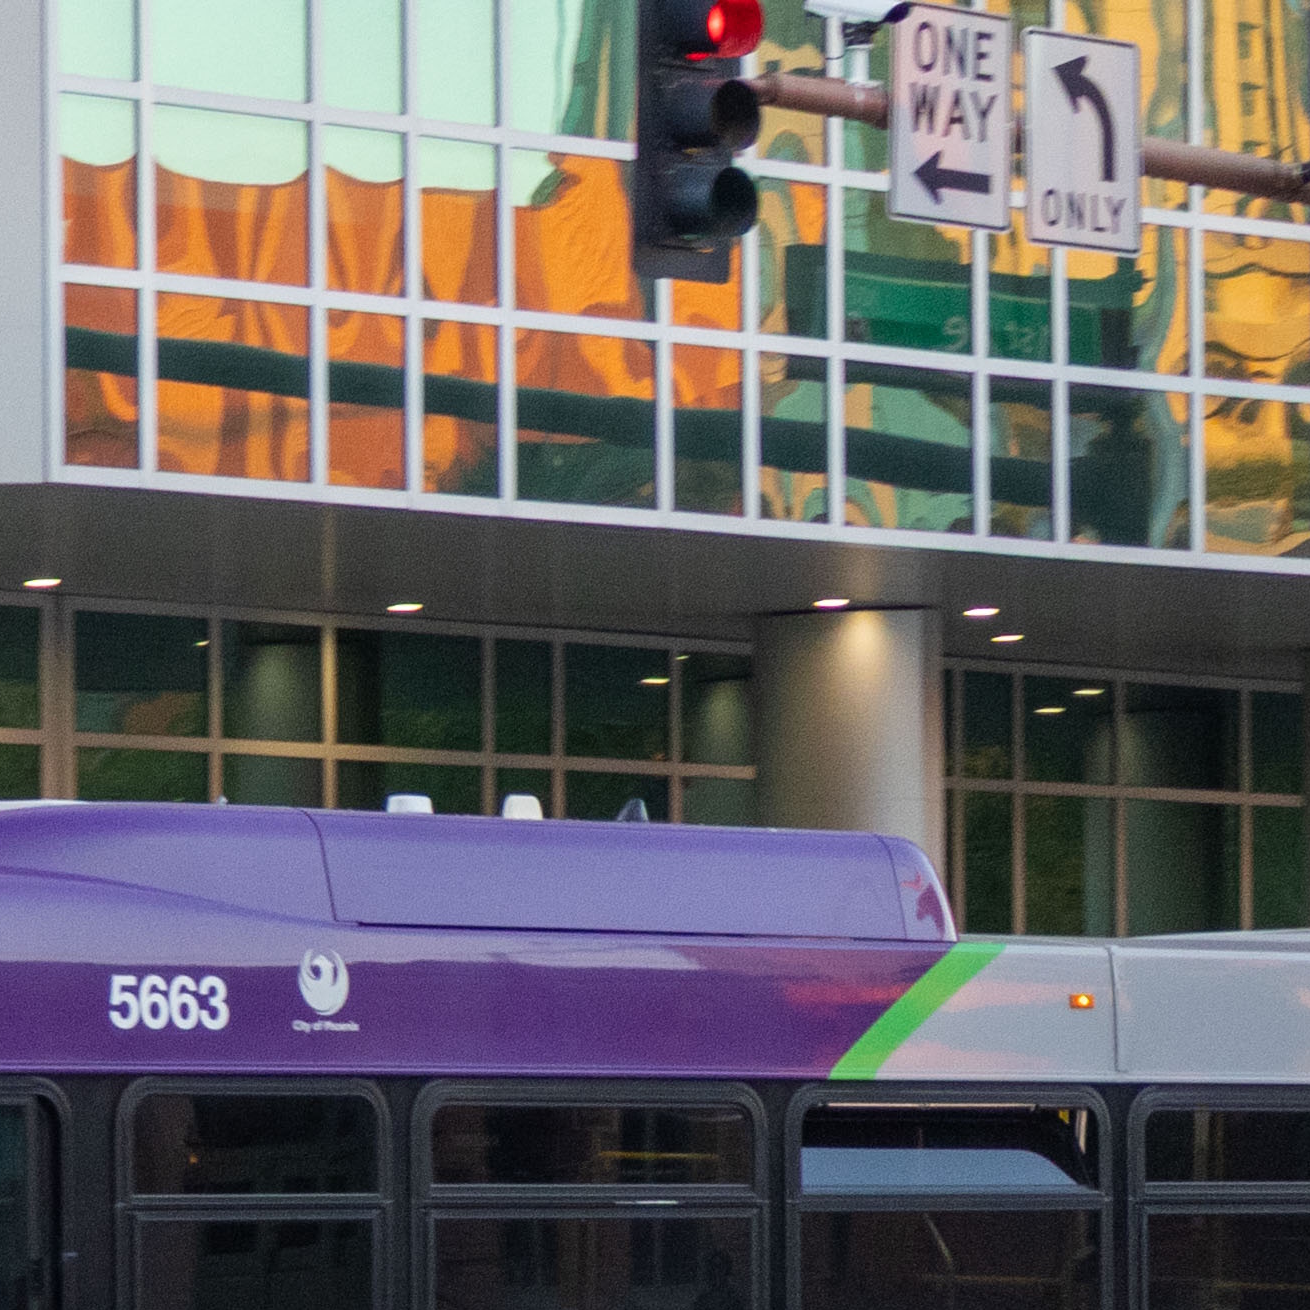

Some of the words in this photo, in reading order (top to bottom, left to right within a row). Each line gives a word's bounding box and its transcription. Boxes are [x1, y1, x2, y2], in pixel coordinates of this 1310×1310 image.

[912, 21, 994, 82] ONE
[909, 82, 998, 143] WAY
[1041, 188, 1127, 235] ONLY
[108, 974, 230, 1030] 5663
